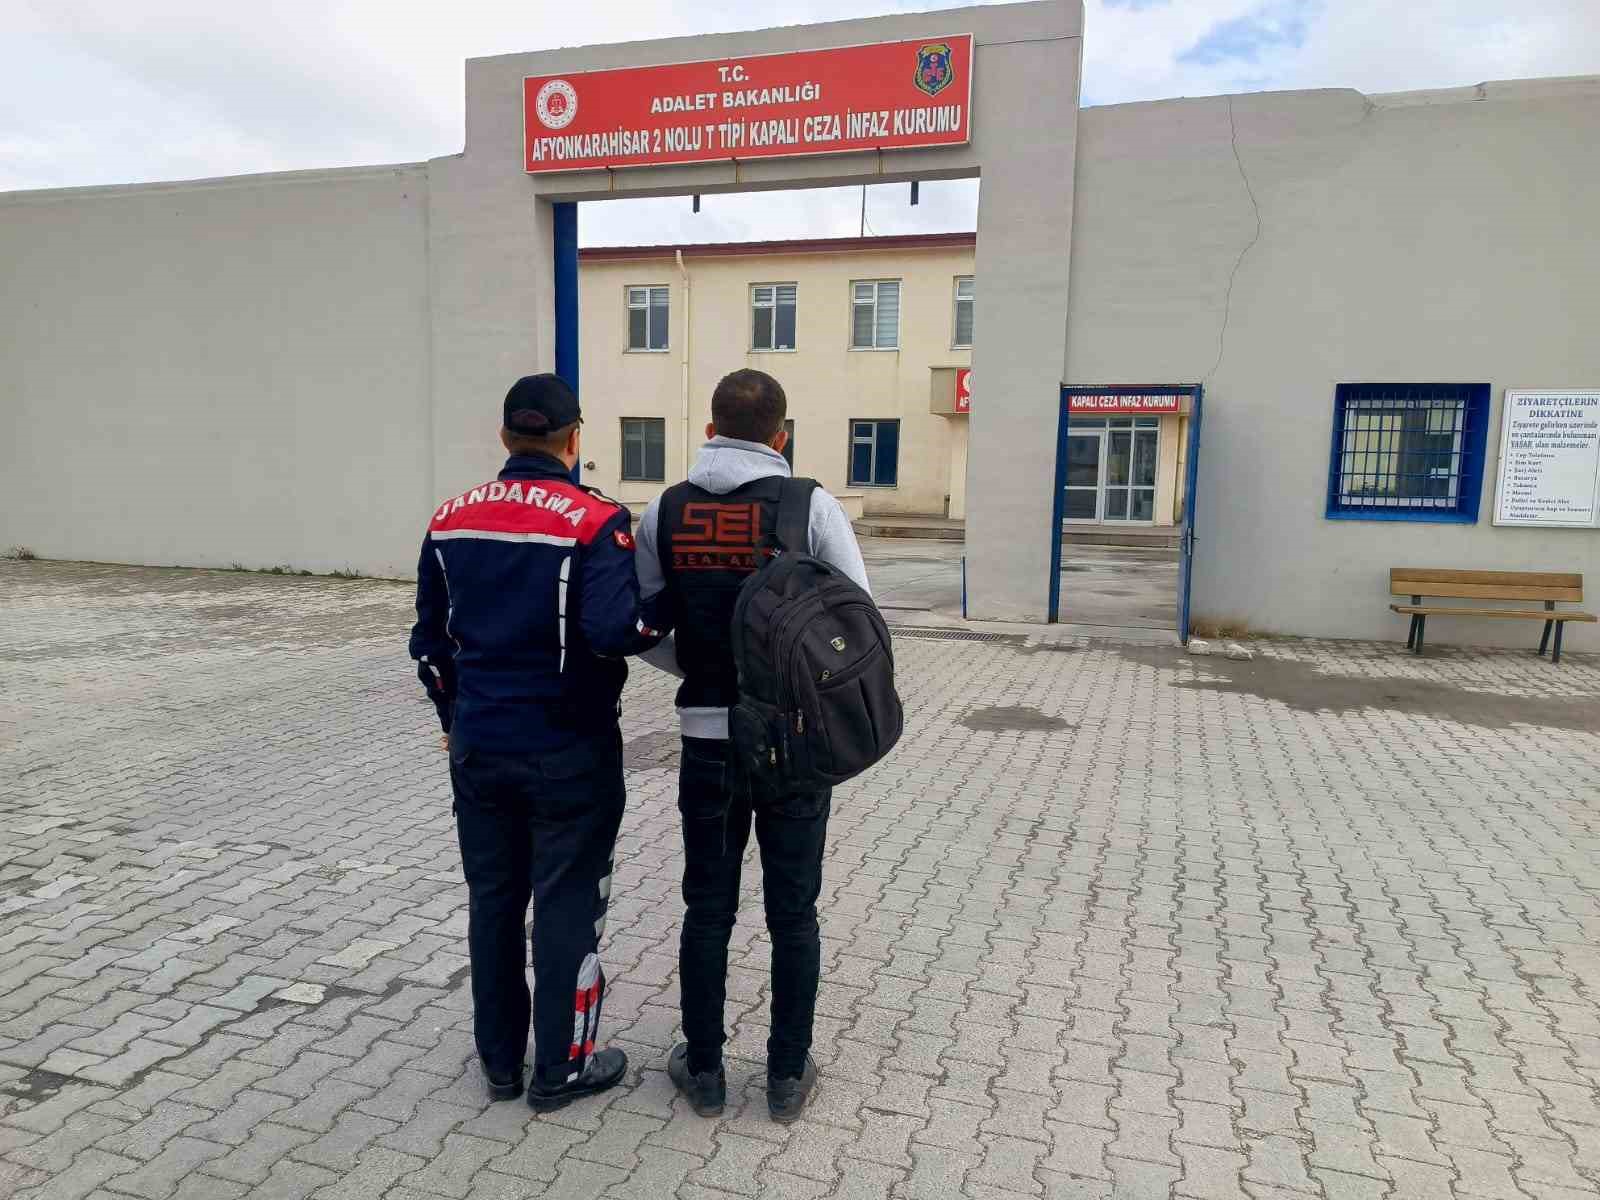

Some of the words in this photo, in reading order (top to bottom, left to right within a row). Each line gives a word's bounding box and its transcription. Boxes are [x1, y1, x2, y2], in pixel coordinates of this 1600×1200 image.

[718, 65, 749, 82] T.C.
[650, 93, 717, 114] ADALET
[722, 81, 820, 108] BAKANLIĞI
[532, 126, 649, 161] AFYONKARAHİSAR
[652, 128, 661, 153] 2
[665, 126, 702, 152] NOLU
[705, 124, 714, 149] T
[718, 117, 745, 149] TİPİ
[749, 118, 799, 147] KAPALI
[803, 114, 842, 143] CEZA
[846, 107, 890, 139] İNFAZ
[893, 104, 961, 135] KURUMU
[1071, 395, 1097, 408] KAPALI
[1098, 395, 1118, 408] CEZA
[1142, 395, 1176, 408] KURUMU
[436, 480, 587, 527] JANDARMA
